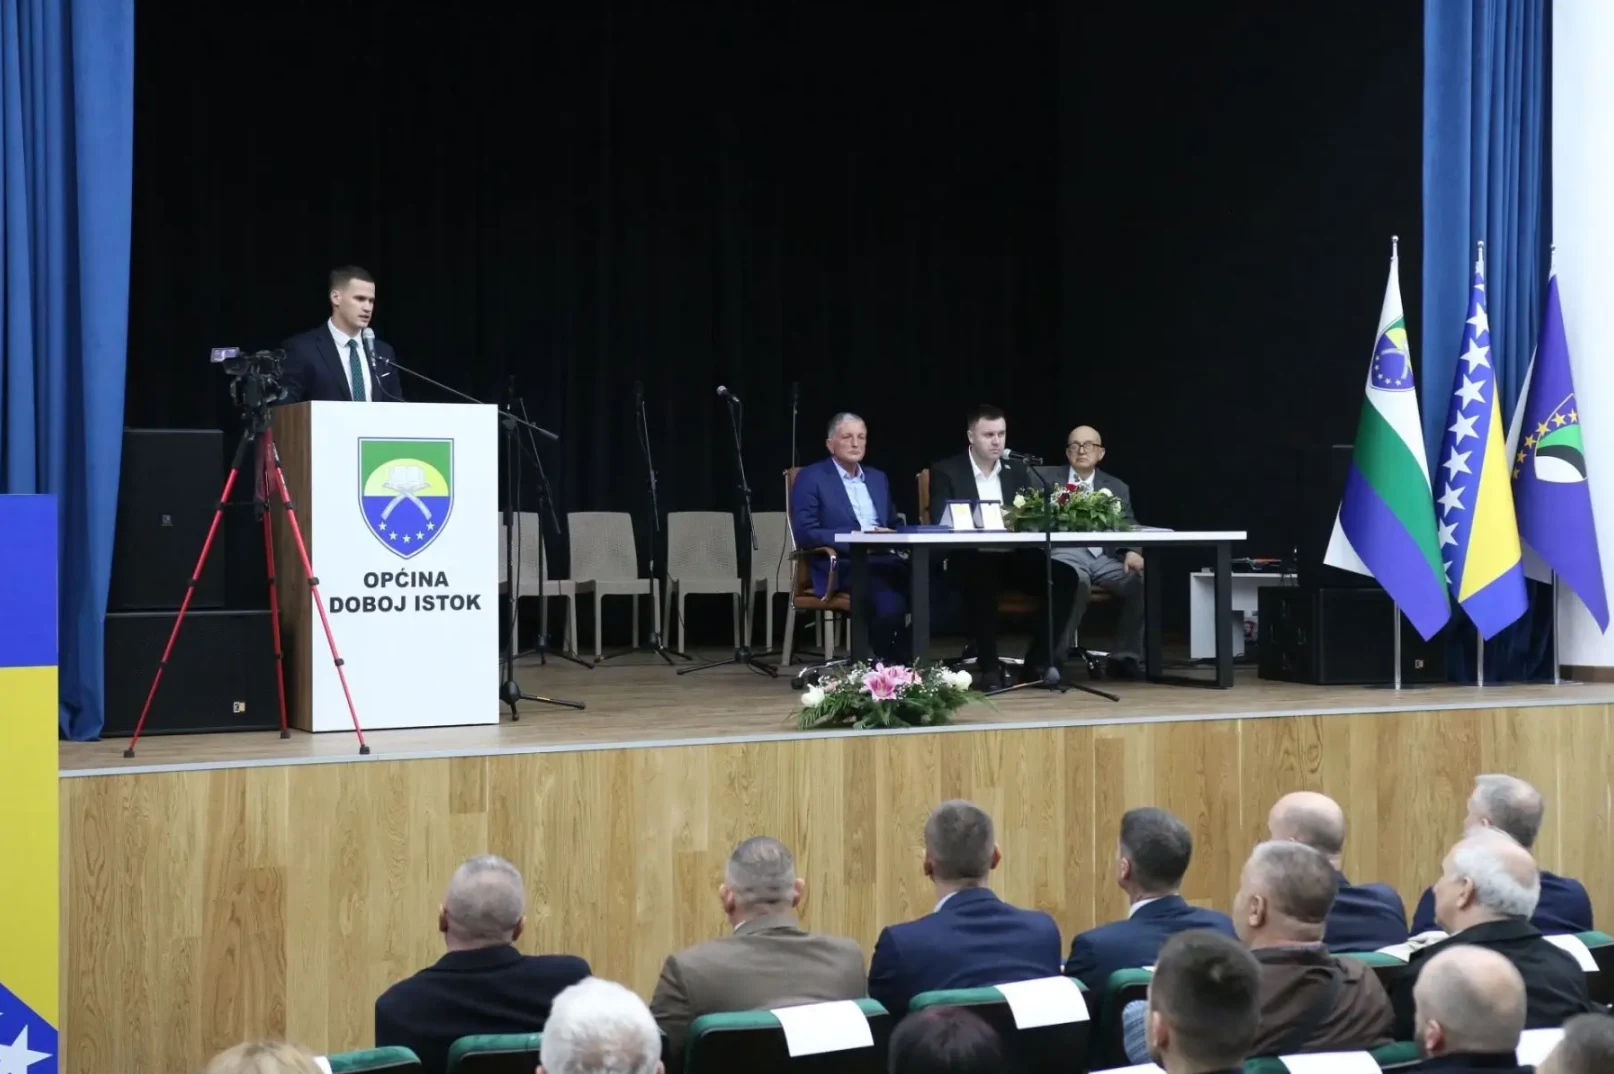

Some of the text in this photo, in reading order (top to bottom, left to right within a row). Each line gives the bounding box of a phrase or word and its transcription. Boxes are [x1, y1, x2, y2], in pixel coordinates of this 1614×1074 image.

[363, 568, 449, 588] OPĆINA
[330, 594, 481, 613] DOBOJ ISTOK
